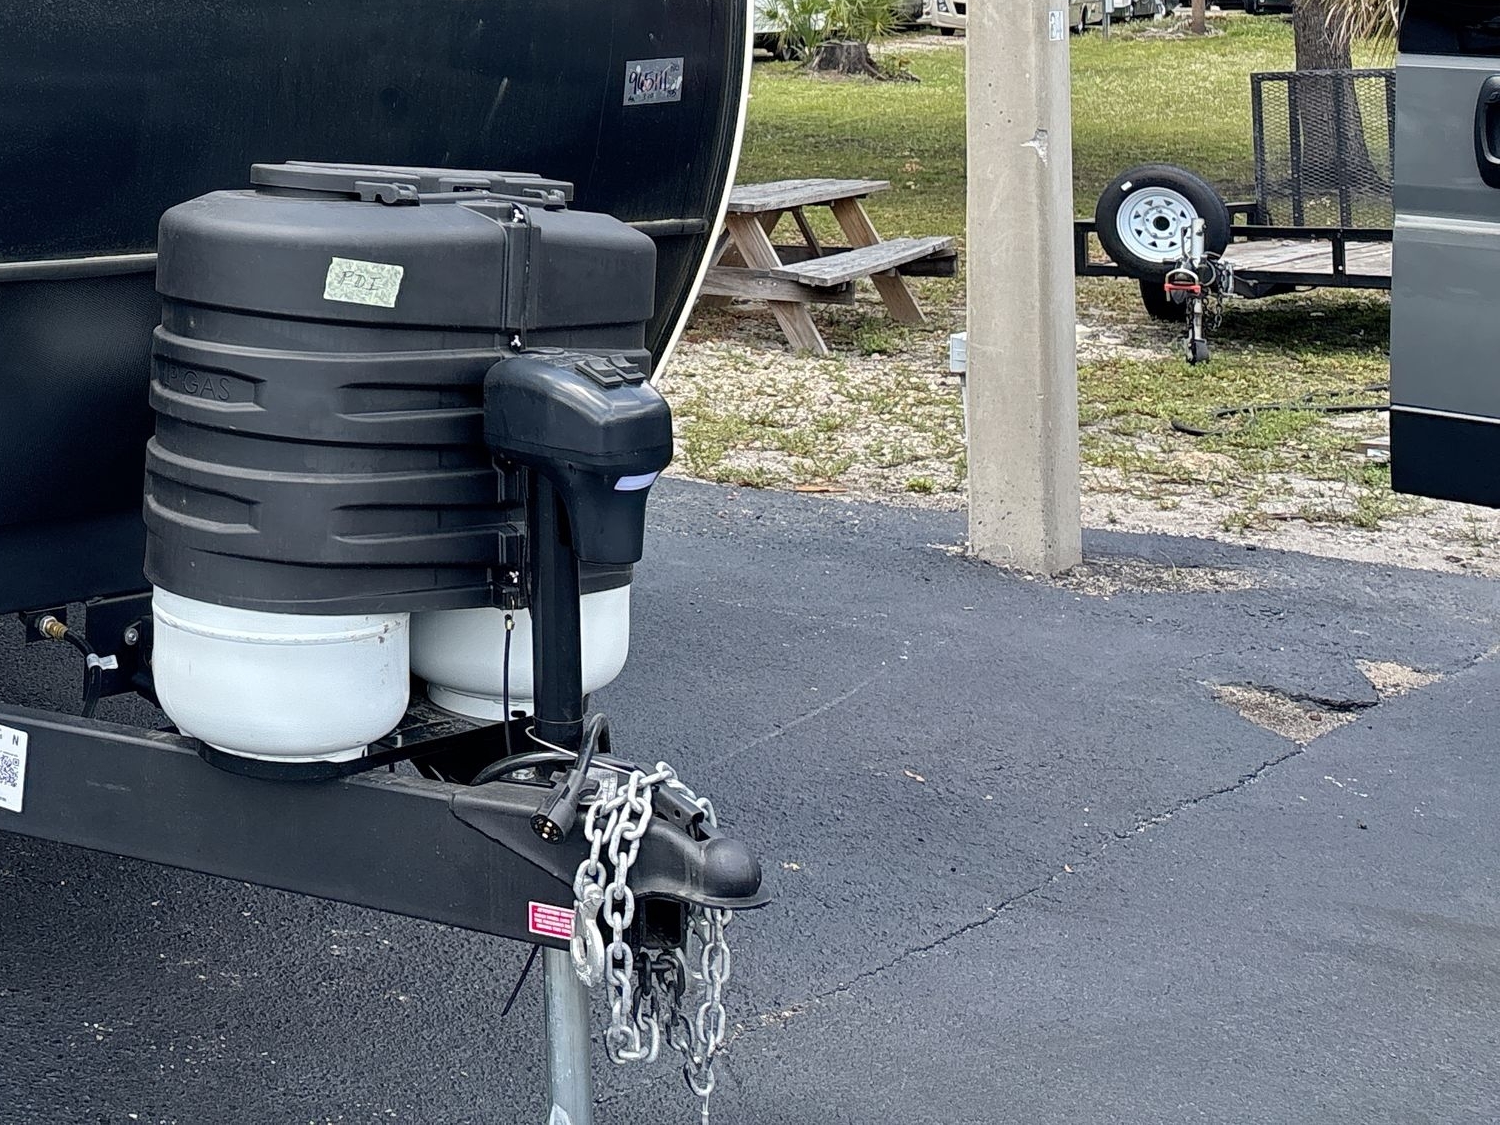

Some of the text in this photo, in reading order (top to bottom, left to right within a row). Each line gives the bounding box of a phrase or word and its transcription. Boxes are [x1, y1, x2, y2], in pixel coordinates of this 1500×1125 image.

[338, 270, 382, 291] PDI
[183, 370, 231, 401] GAS
[12, 734, 20, 746] N
